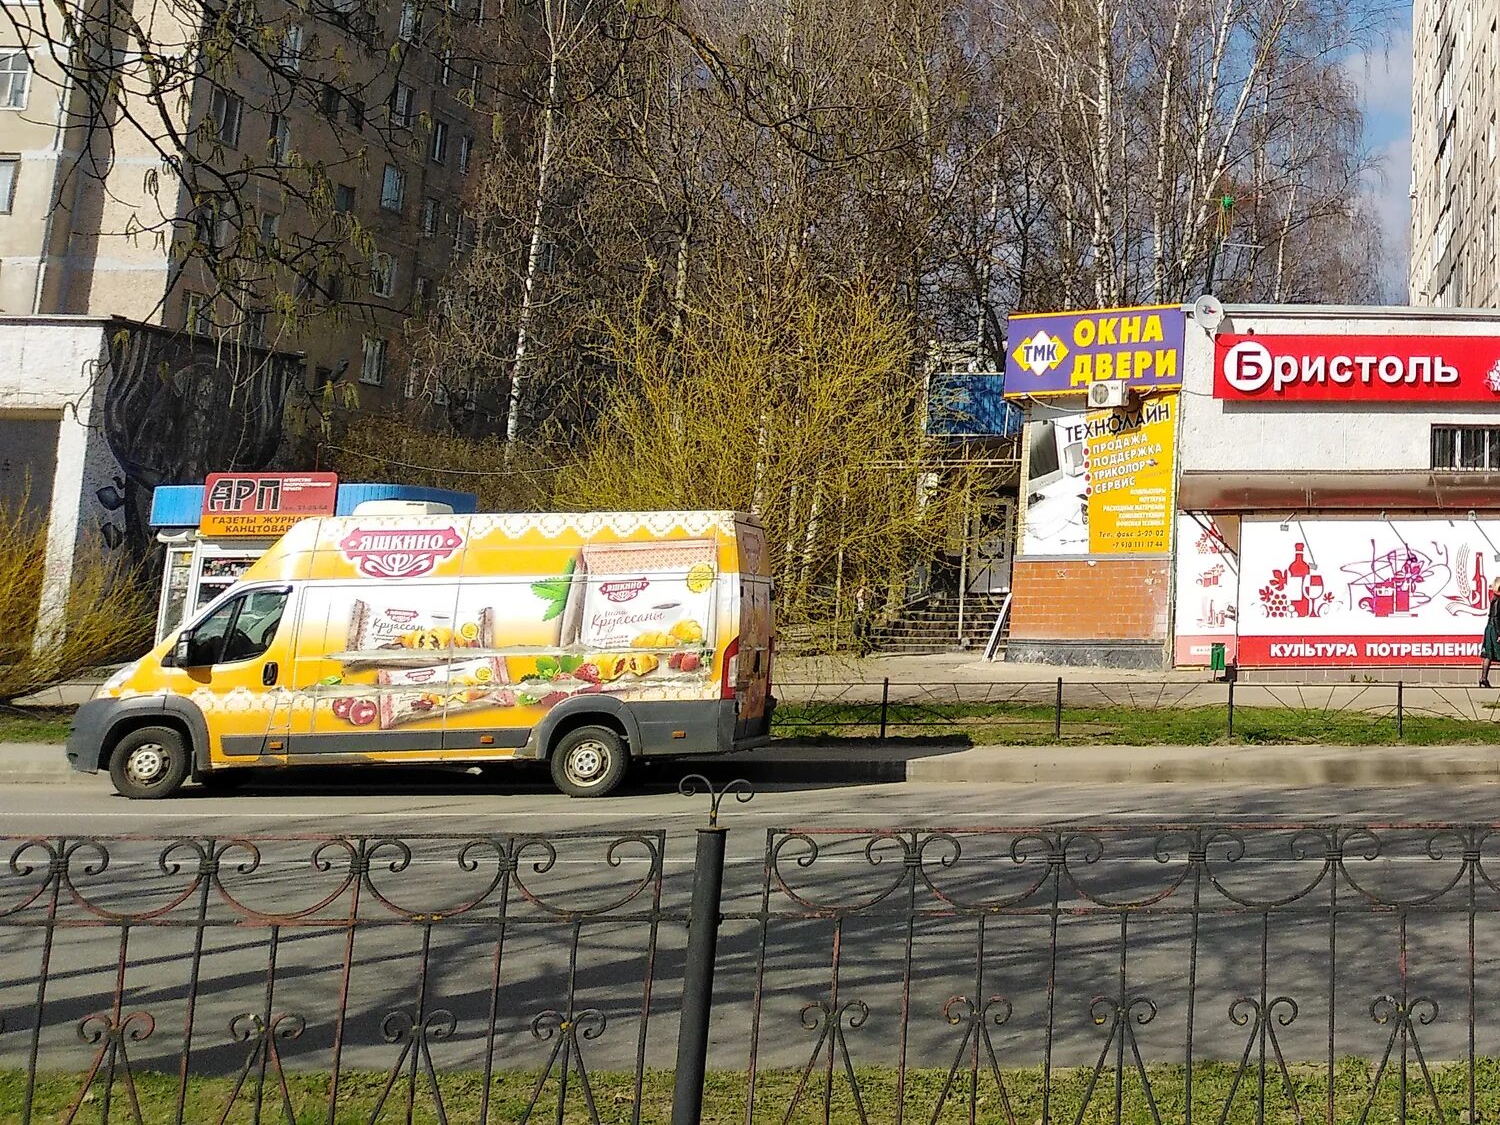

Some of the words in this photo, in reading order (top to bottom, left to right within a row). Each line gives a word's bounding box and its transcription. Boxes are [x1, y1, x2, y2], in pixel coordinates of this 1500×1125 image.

[1073, 315, 1163, 347] ОКНА
[1023, 343, 1057, 363] ТМК
[1070, 349, 1177, 387] ДВЕРИ
[1236, 350, 1459, 391] Бристоль
[1065, 403, 1170, 443] ТЕХНОЛАЙН
[1092, 434, 1148, 454] ПРОДАЖА
[1093, 443, 1163, 467] ПОДДЕРЖКА
[1094, 461, 1146, 481] ТРИКОЛОР
[208, 478, 282, 511] АРП
[1095, 476, 1136, 493] СЕРВИС
[212, 516, 257, 524] ГАЗЕТЫ
[225, 524, 293, 533] КАНЦТОВАР
[358, 534, 444, 550] ЯШКИНО
[606, 581, 641, 591] ЯШКИНО
[373, 617, 425, 634] Круассан
[590, 612, 665, 636] Круассаны
[1270, 643, 1358, 657] КУЛЬТУРА
